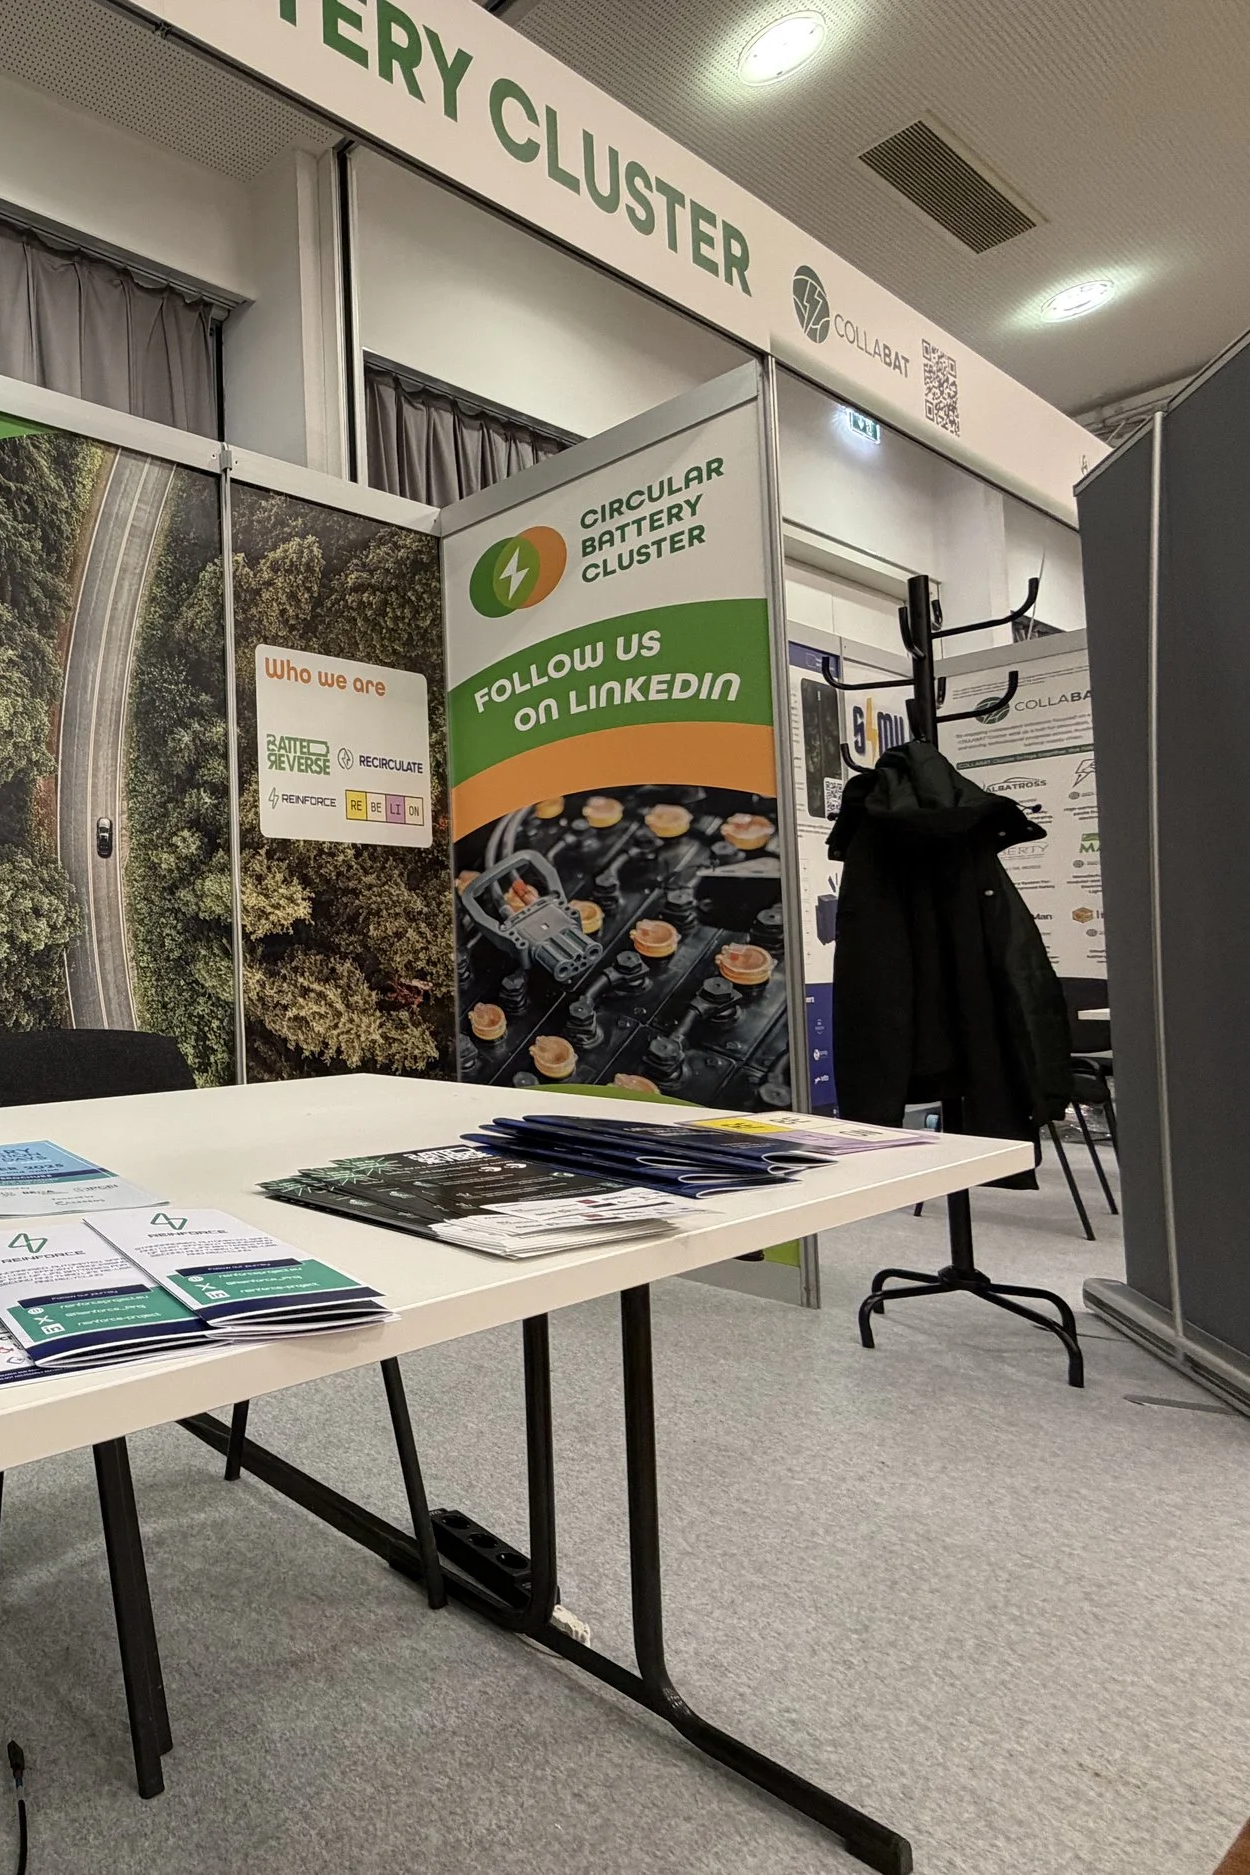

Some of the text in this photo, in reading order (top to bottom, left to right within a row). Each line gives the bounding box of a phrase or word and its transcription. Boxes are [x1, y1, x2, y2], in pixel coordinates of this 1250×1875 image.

[489, 78, 752, 296] CLUSTER
[834, 314, 910, 378] COLLABAT
[580, 457, 724, 529] CIRCULAR
[582, 494, 703, 557] BATTERY
[582, 525, 705, 582] CLUSTER
[265, 657, 386, 696] Who we are
[474, 630, 661, 713] FOLLOW US
[569, 673, 741, 714] LINKEDIN
[359, 755, 423, 773] RECIRCULATE
[282, 794, 336, 808] REINFORCE
[1, 1250, 85, 1263] REINFORCE
[148, 1229, 228, 1238] REINFORCE
